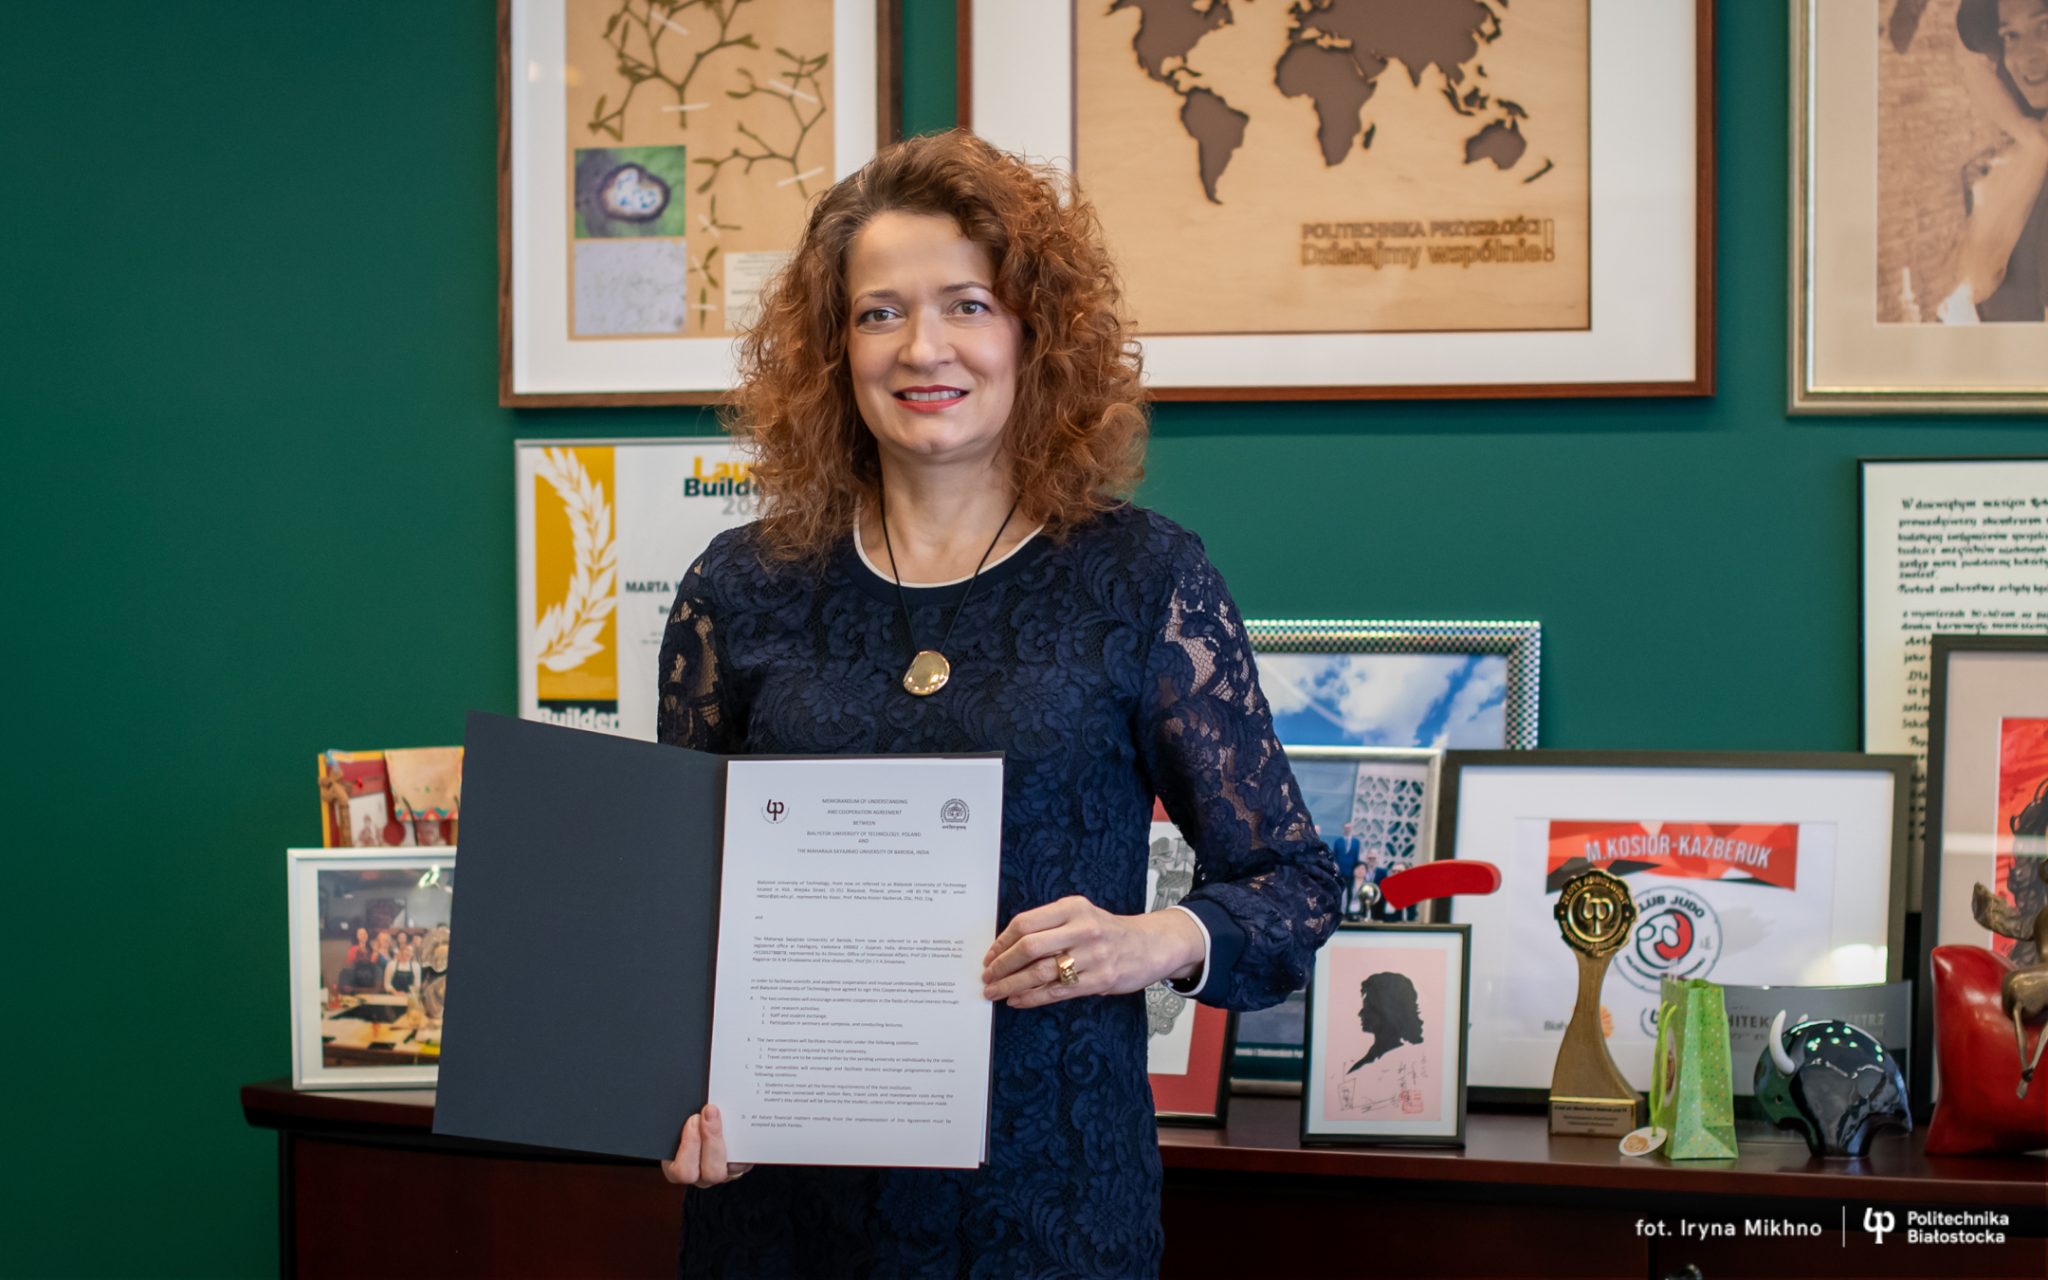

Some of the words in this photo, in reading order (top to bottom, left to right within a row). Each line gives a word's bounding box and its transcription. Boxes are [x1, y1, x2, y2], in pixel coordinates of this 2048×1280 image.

[625, 581, 670, 593] MARTA
[1584, 834, 1772, 869] M.KOSIOR-KAZBERUK
[1670, 895, 1706, 918] JUDO
